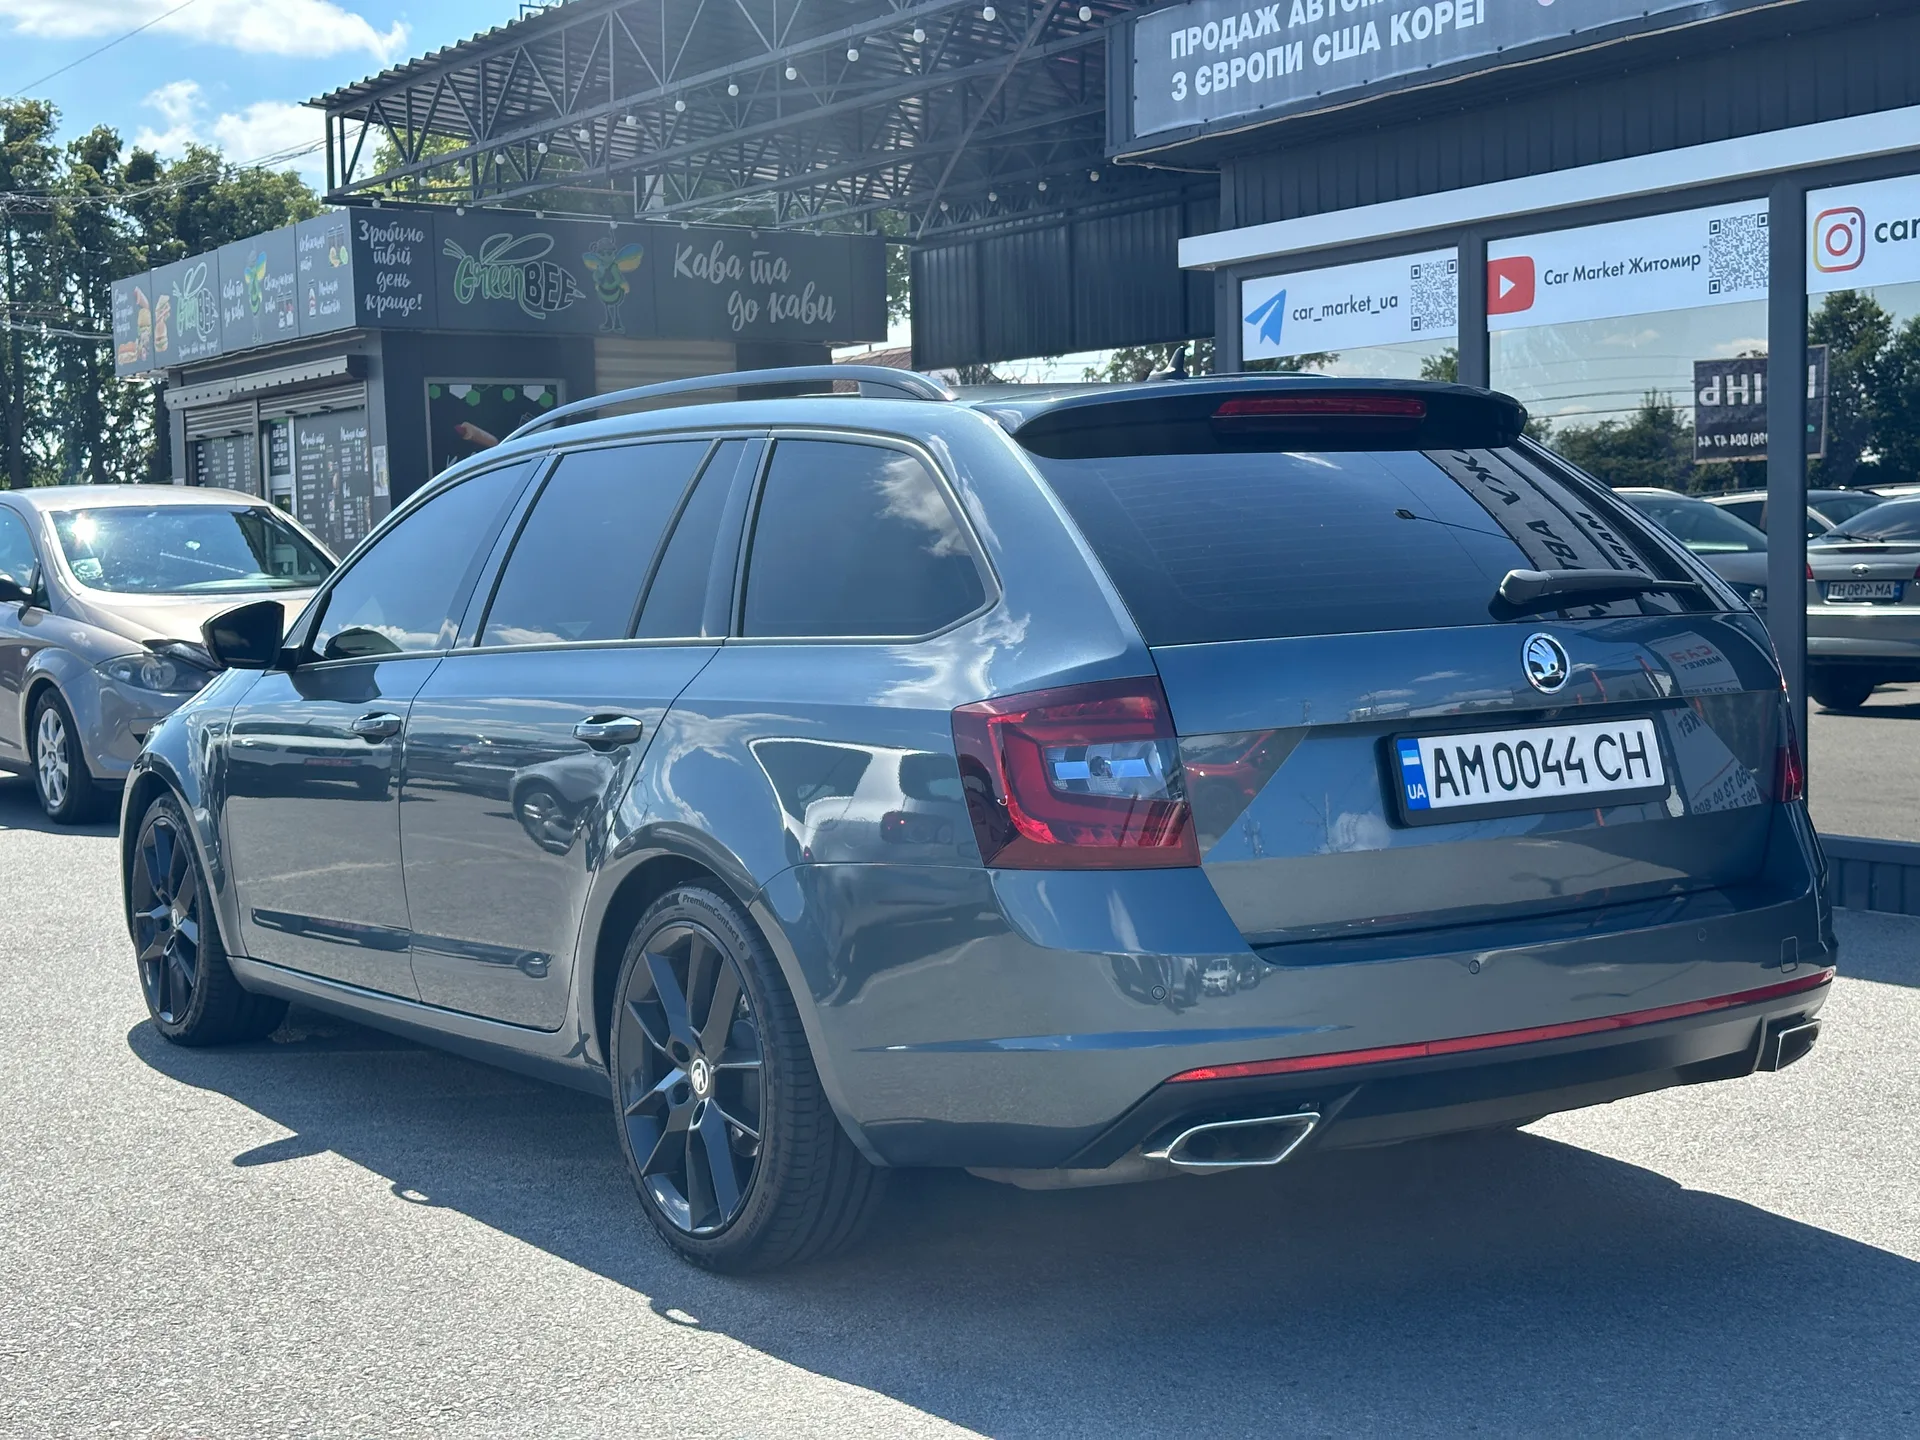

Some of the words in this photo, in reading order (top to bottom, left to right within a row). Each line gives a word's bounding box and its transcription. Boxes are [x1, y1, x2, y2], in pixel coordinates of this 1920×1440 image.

[1171, 3, 1281, 60] ПРОДАЖ
[1171, 71, 1188, 101] З
[1195, 41, 1303, 96] ЄВРОПИ
[1312, 21, 1381, 66] США
[359, 219, 425, 249] Зробимо
[373, 243, 413, 265] твій
[673, 239, 745, 284] Кава
[750, 251, 791, 285] та
[1544, 269, 1569, 286] Car
[1572, 261, 1625, 283] Market
[1628, 253, 1702, 275] Житомир
[376, 271, 412, 293] день
[364, 293, 423, 319] краще!
[727, 290, 760, 332] до
[767, 281, 837, 325] кави
[1292, 294, 1399, 322] car_market_ua
[1594, 730, 1651, 782] CH
[1407, 783, 1427, 800] UA
